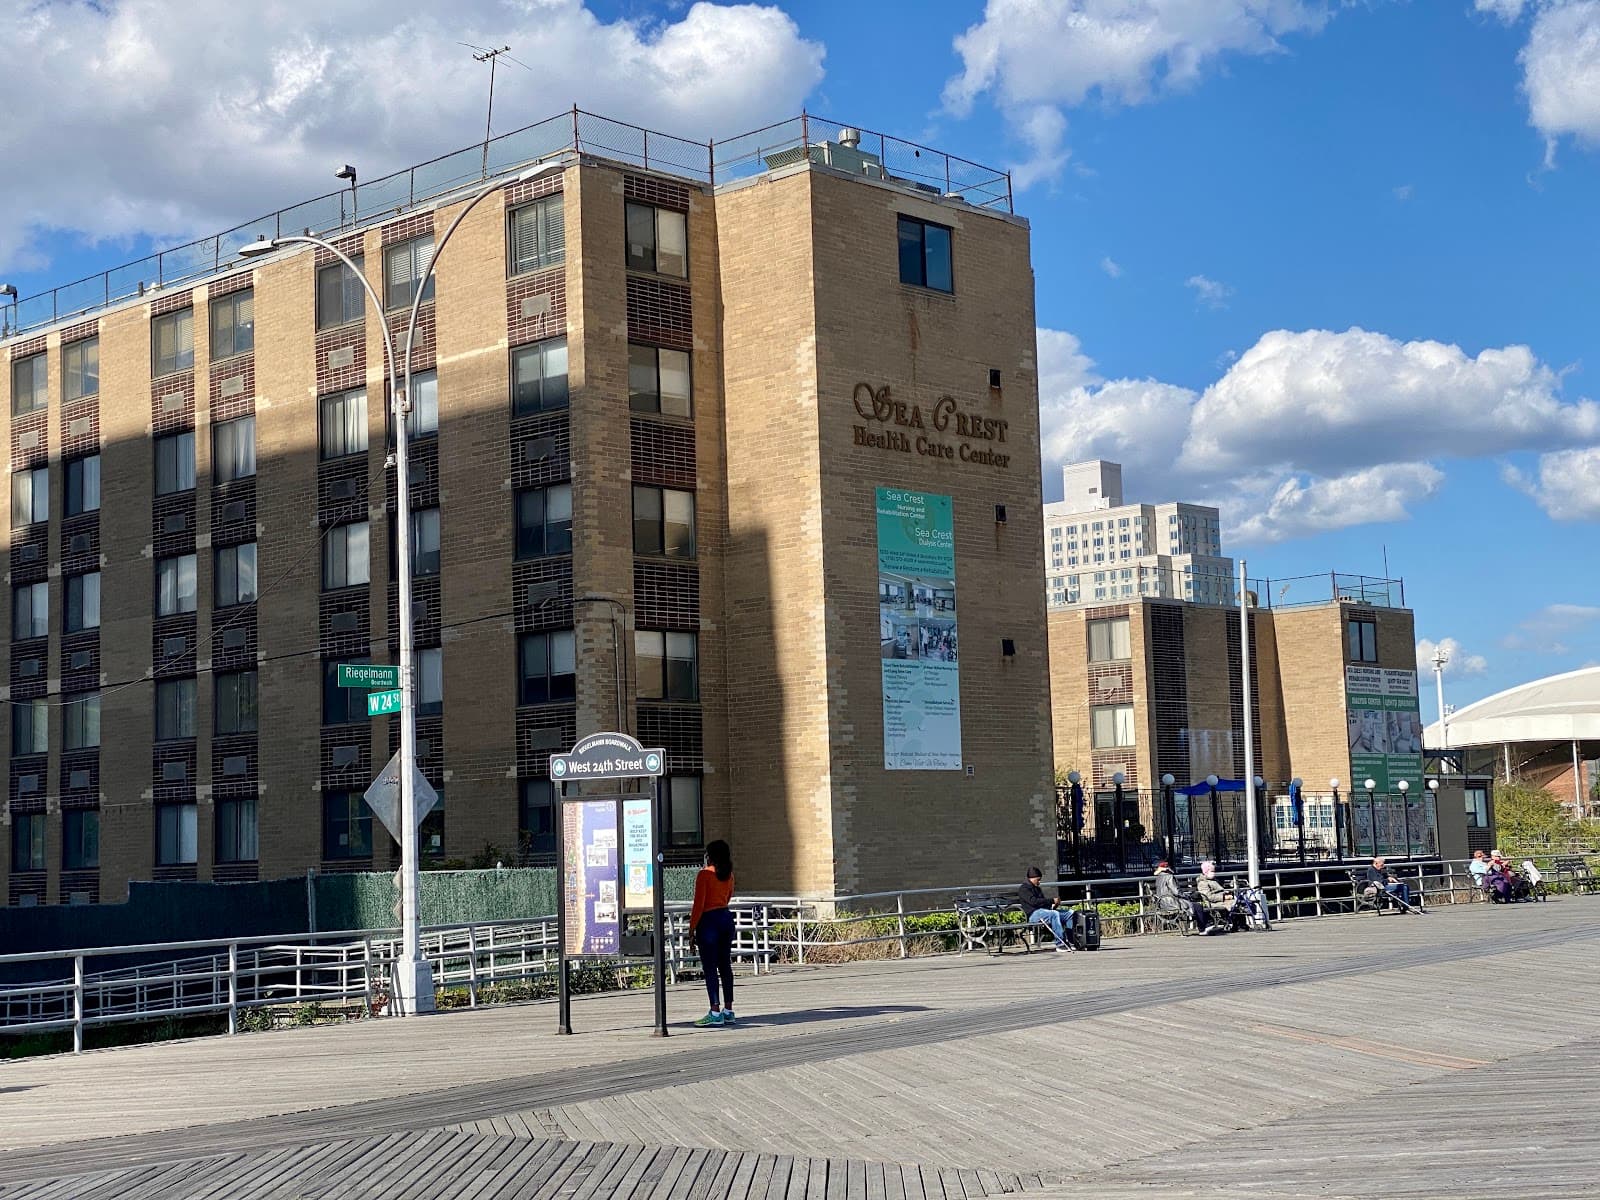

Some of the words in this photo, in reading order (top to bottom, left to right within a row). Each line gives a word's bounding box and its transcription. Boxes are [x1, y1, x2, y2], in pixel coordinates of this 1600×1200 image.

[853, 382, 925, 428] SEA
[933, 395, 1009, 443] CREST
[853, 424, 911, 453] Health
[916, 436, 955, 460] Care
[959, 443, 1010, 468] Center
[886, 490, 902, 501] Sea
[903, 493, 925, 505] Crest
[897, 504, 915, 513] Nursing
[914, 527, 930, 538] Sea
[931, 529, 953, 540] Crest
[918, 538, 937, 548] Dialysis
[936, 541, 953, 549] Center
[345, 666, 393, 682] Riegelmann
[370, 695, 380, 712] W
[380, 693, 393, 711] 24
[578, 739, 605, 755] RIEGELMANN
[605, 738, 633, 753] BOARDWALK
[568, 760, 591, 774] West
[592, 759, 613, 774] 24th
[615, 757, 644, 771] Street
